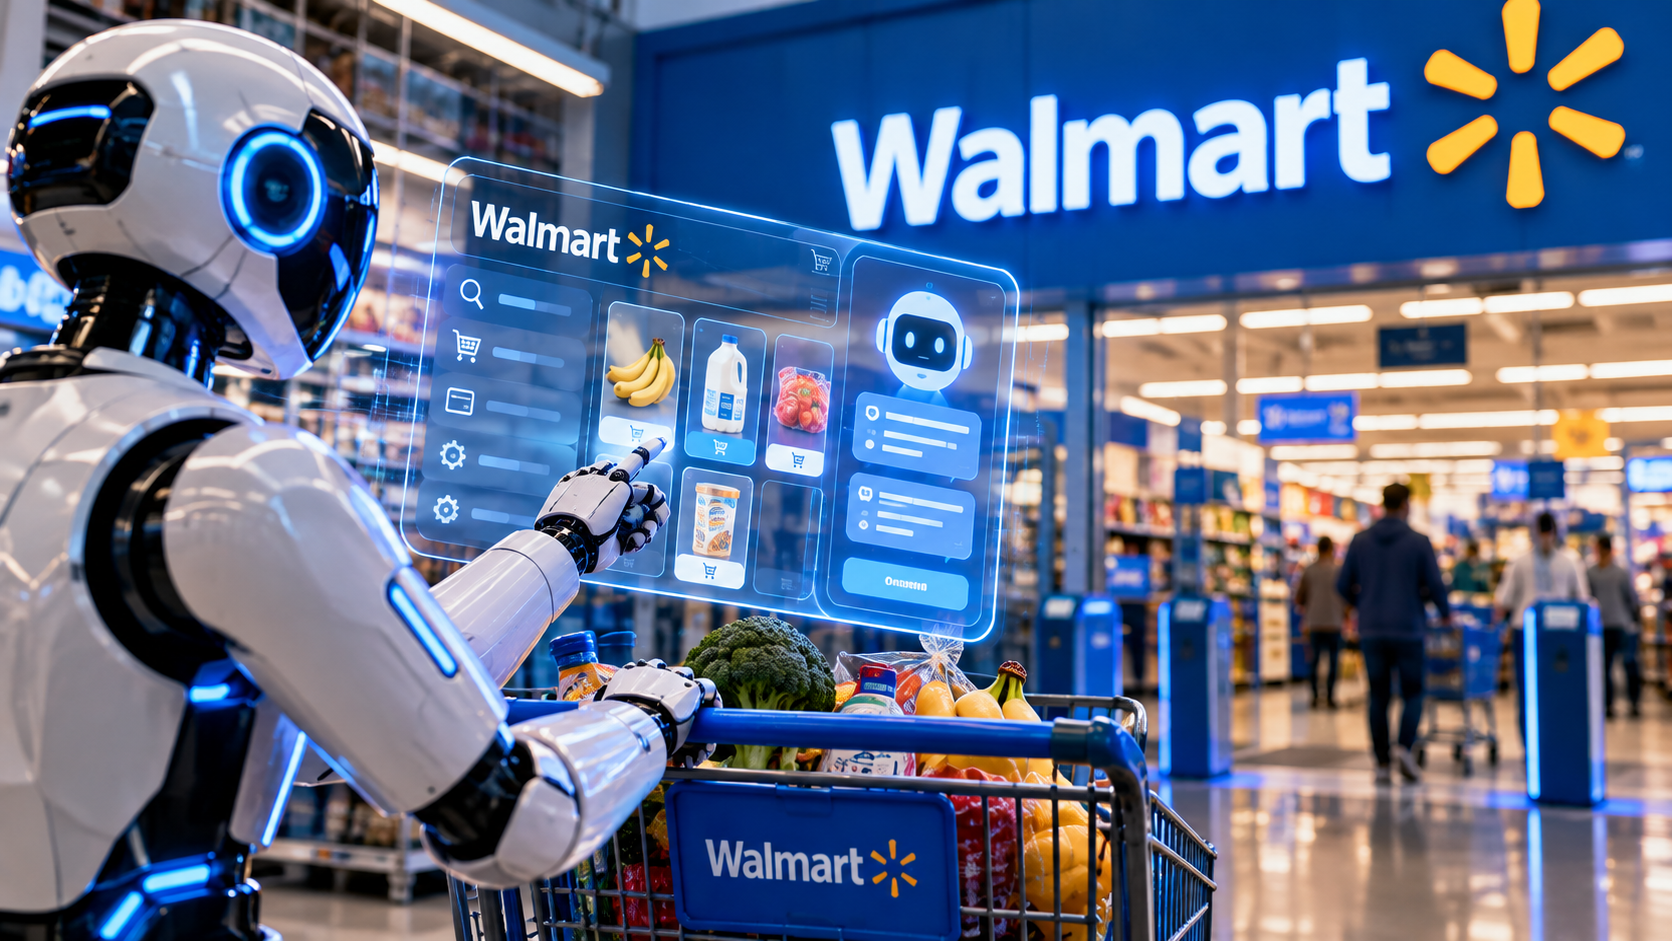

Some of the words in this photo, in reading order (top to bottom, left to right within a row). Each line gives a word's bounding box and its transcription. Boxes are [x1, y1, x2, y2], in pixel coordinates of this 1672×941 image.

[831, 57, 1391, 231] Walmart
[471, 200, 621, 264] Walmart
[705, 838, 865, 886] Walmart
